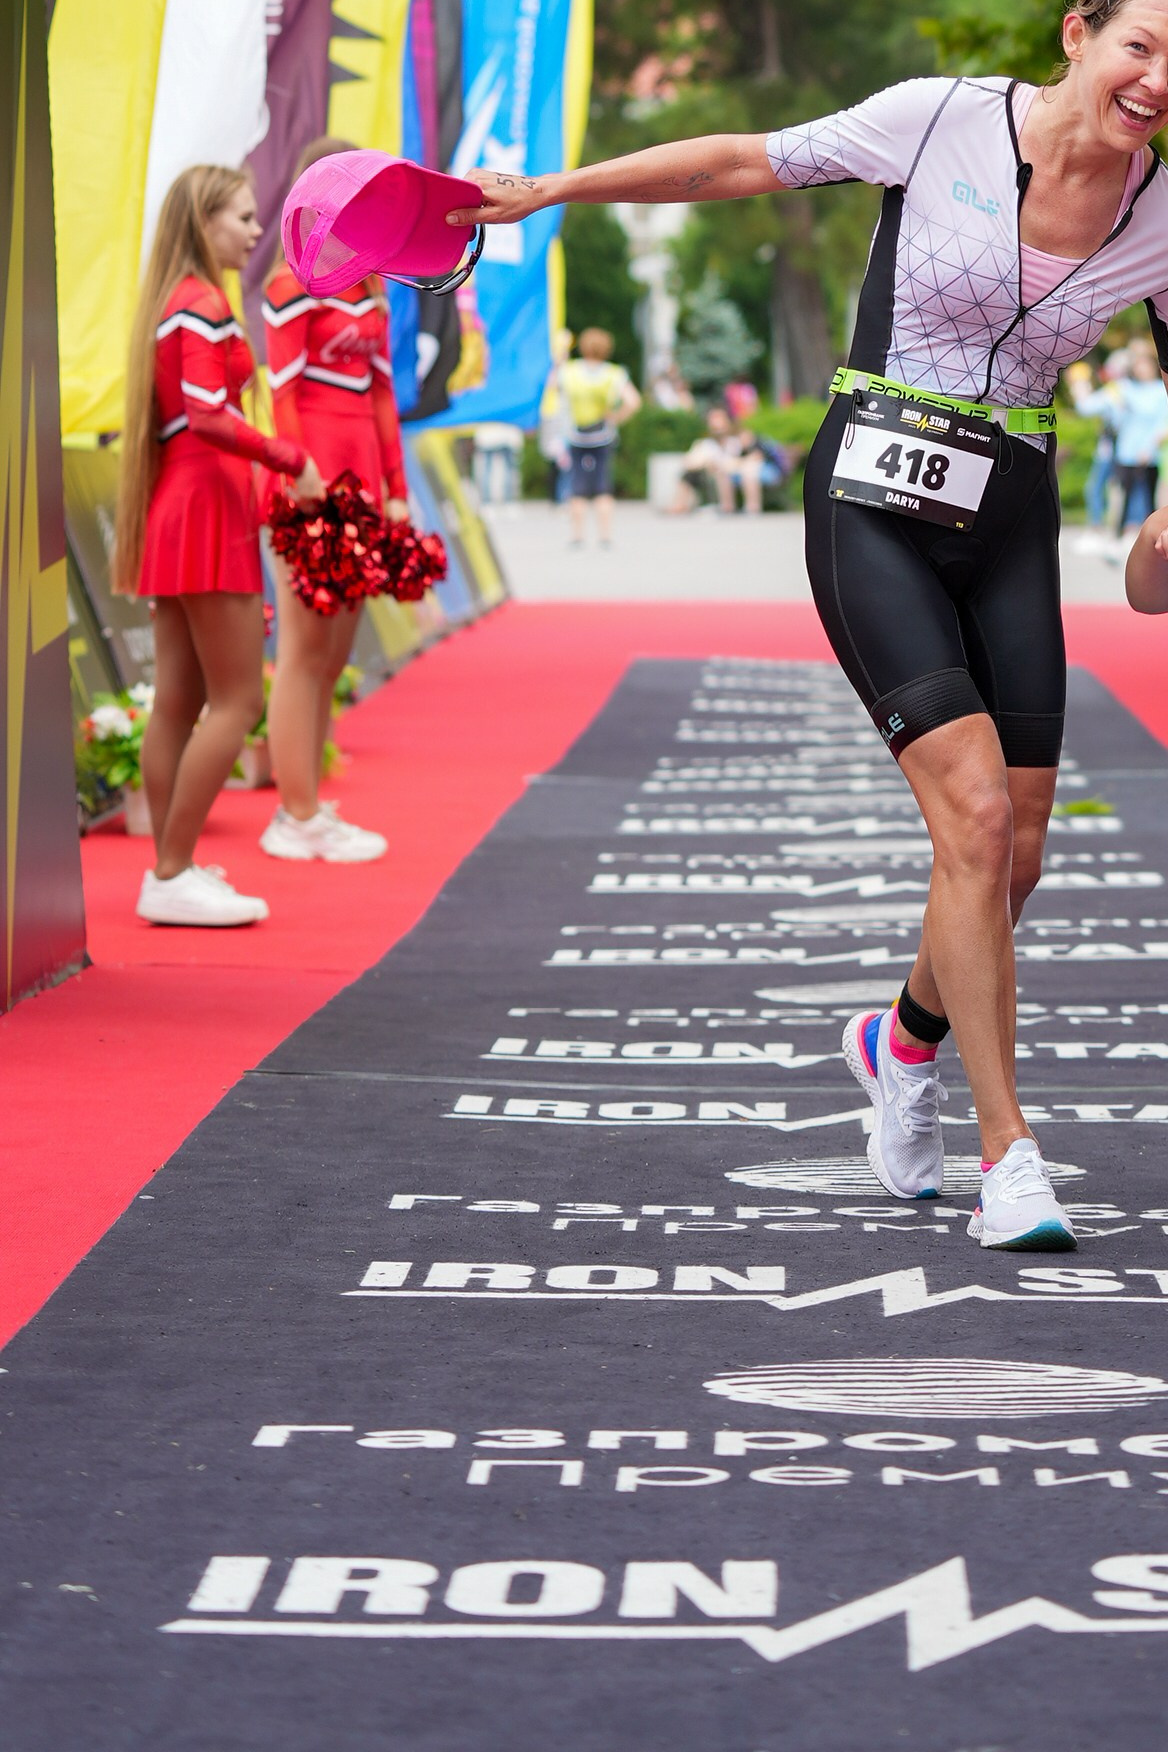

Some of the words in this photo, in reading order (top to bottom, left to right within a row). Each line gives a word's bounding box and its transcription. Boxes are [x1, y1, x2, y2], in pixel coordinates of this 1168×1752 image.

[901, 408, 922, 421] IRON
[928, 415, 951, 430] STAR
[874, 442, 950, 491] 418
[885, 491, 920, 511] DARYA
[490, 1037, 794, 1058] IRON
[453, 1094, 786, 1120] IRON
[358, 1261, 786, 1290] IRON
[187, 1555, 778, 1618] IRON
